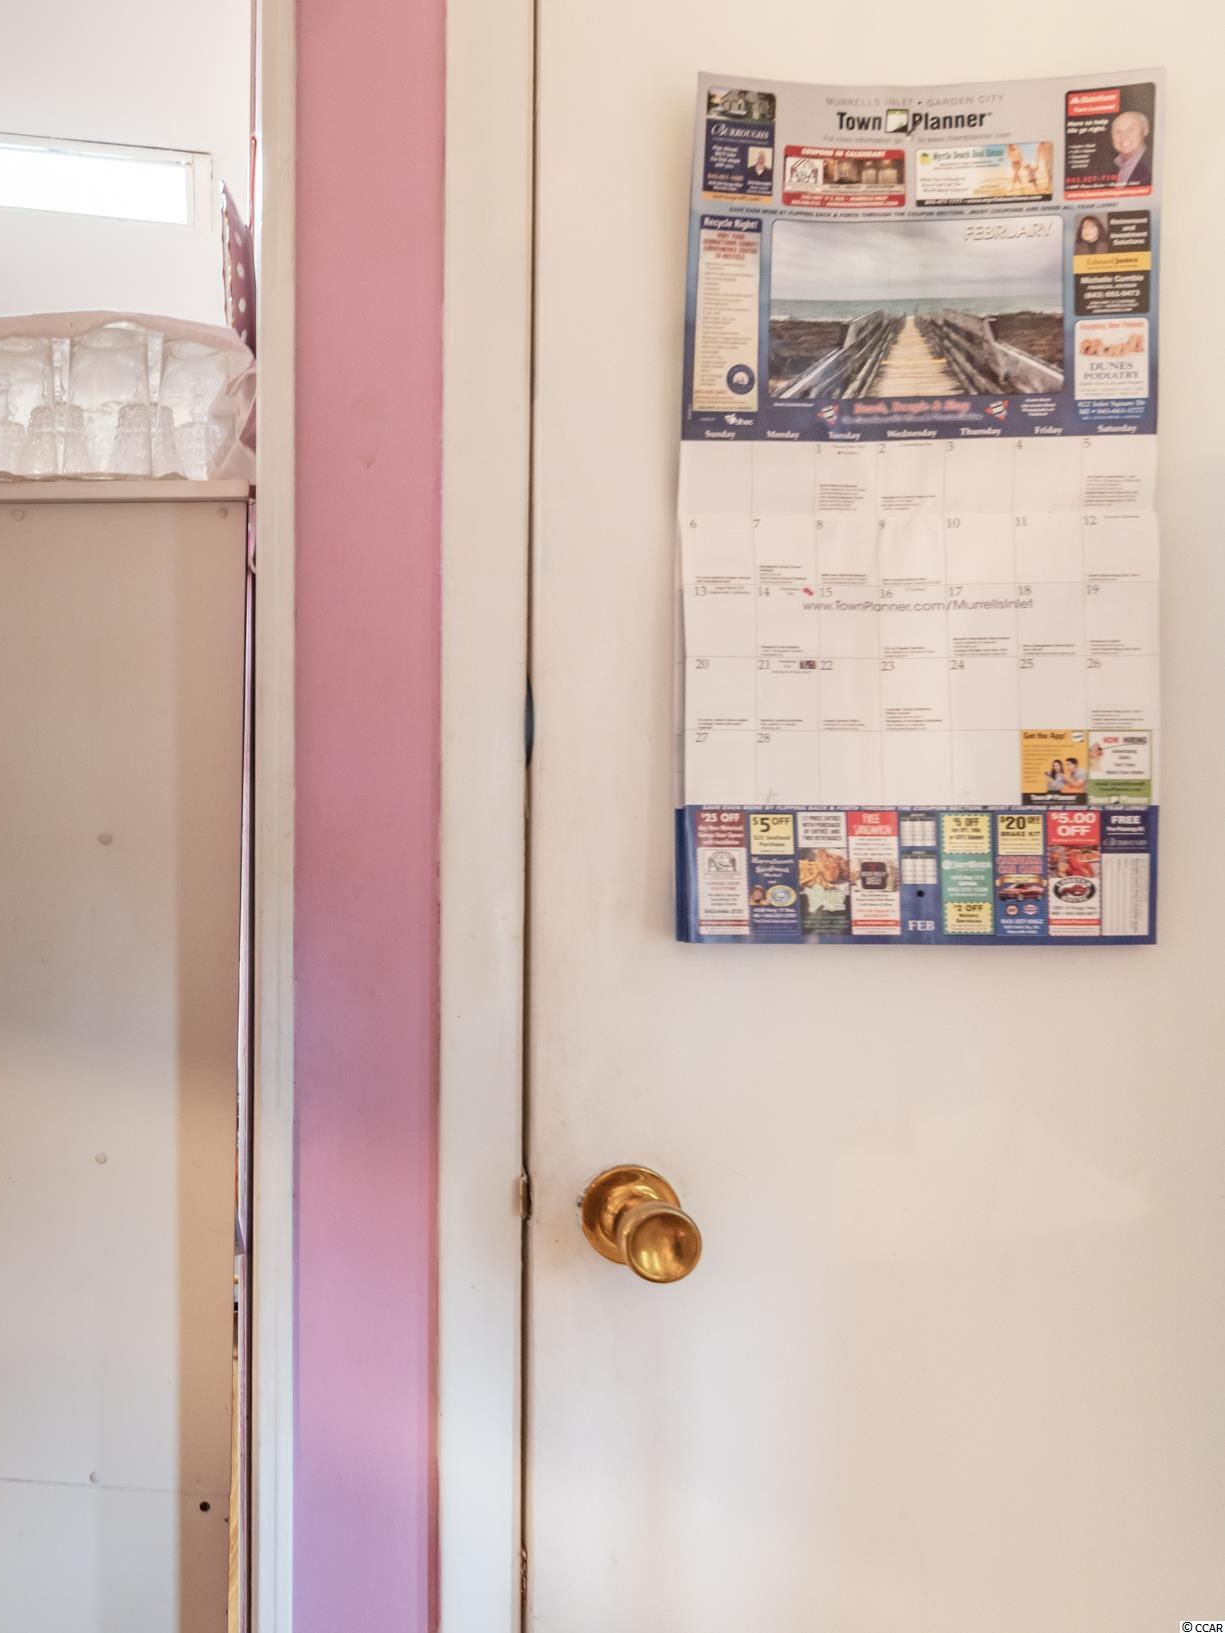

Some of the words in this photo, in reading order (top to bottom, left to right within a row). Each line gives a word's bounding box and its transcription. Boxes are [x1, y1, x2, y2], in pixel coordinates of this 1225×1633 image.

[927, 97, 975, 107] GARDEN
[978, 94, 1005, 105] CITY
[837, 112, 882, 131] Town
[911, 112, 986, 131] Planner
[704, 217, 733, 229] Recycle
[734, 219, 759, 231] Right!
[965, 222, 1053, 241] FEBRUARY
[1090, 361, 1134, 371] DUNES
[1083, 371, 1139, 381] PODIATRY
[704, 430, 736, 441] Sunday
[766, 430, 800, 441] Monday
[828, 431, 861, 442] Tuesday
[887, 429, 937, 439] Wednesday
[960, 427, 1001, 438] Thursday
[1034, 426, 1063, 436] Friday
[1097, 424, 1138, 434] Saturday
[816, 443, 822, 453] 1
[946, 441, 954, 451] 3
[1015, 440, 1024, 450] 4
[1083, 438, 1091, 448] 5
[878, 443, 887, 454] 2
[689, 519, 697, 529] 6
[753, 518, 760, 529] 7
[816, 519, 824, 529] 8
[878, 520, 885, 530] 9
[946, 518, 961, 528] 10
[1015, 517, 1027, 527] 11
[1083, 515, 1097, 526] 12
[694, 586, 708, 597] 13
[757, 587, 770, 597] 14
[820, 587, 833, 597] 15
[880, 588, 894, 599] 16
[949, 586, 963, 597] 17
[1018, 585, 1032, 595] 18
[1086, 584, 1100, 595] 19
[696, 659, 709, 669] 20
[757, 660, 770, 670] 21
[820, 660, 833, 670] 22
[881, 661, 895, 671] 23
[950, 659, 965, 670] 24
[1019, 658, 1034, 669] 25
[1087, 658, 1101, 669] 26
[696, 733, 708, 743] 27
[757, 733, 770, 743] 28
[1023, 732, 1036, 740] Get
[1037, 732, 1049, 740] the
[701, 812, 718, 822] $25
[720, 812, 740, 822] OFF
[773, 817, 791, 826] OFF
[964, 818, 980, 826] OFF
[1050, 813, 1096, 824] $5.00
[1111, 816, 1141, 824] FREE
[1001, 816, 1026, 830] $20
[1056, 826, 1091, 836] OFF
[965, 904, 983, 912] OFF
[908, 920, 935, 931] FEB
